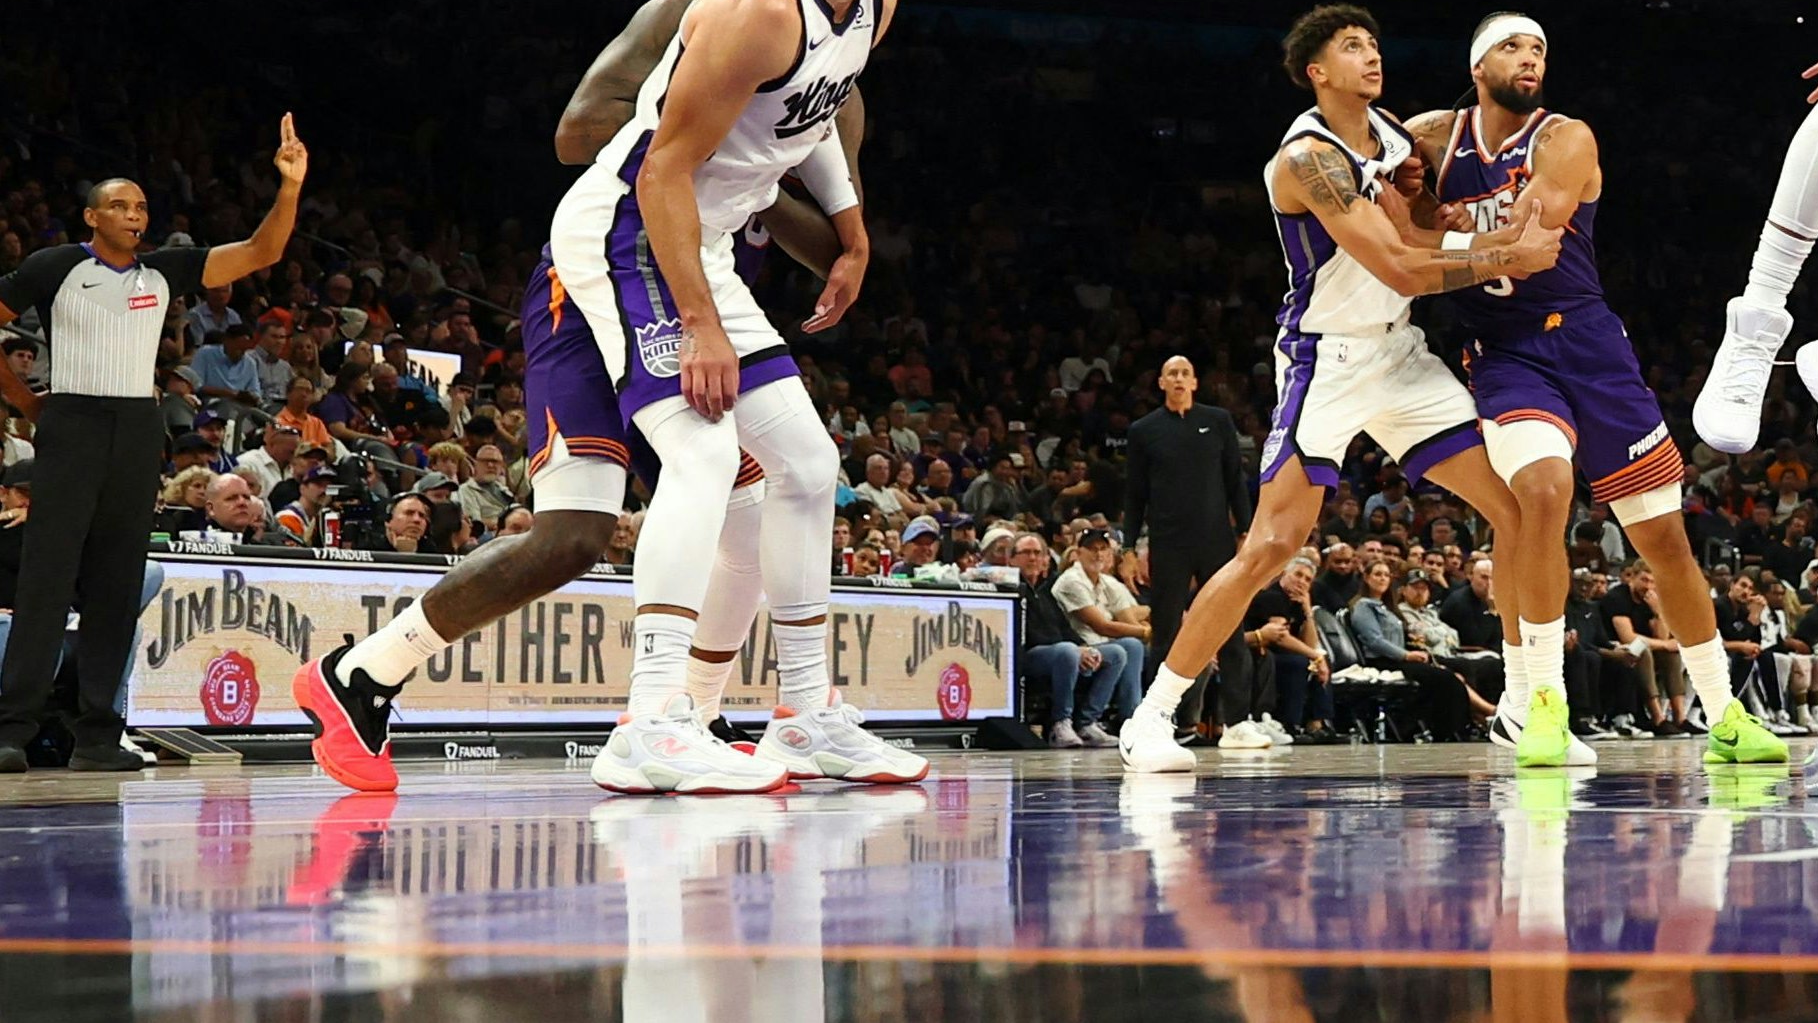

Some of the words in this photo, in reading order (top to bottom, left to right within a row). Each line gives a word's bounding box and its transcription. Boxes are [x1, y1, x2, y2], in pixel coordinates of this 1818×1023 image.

[643, 339, 682, 360] KING
[185, 541, 235, 556] FANDUEL
[328, 548, 374, 562] FANDUEL
[147, 586, 217, 669] JIM
[222, 569, 315, 665] BEAM
[905, 614, 944, 677] JIM
[948, 601, 1002, 679] BEAM
[223, 680, 237, 704] B
[458, 746, 500, 759] FANDUEL
